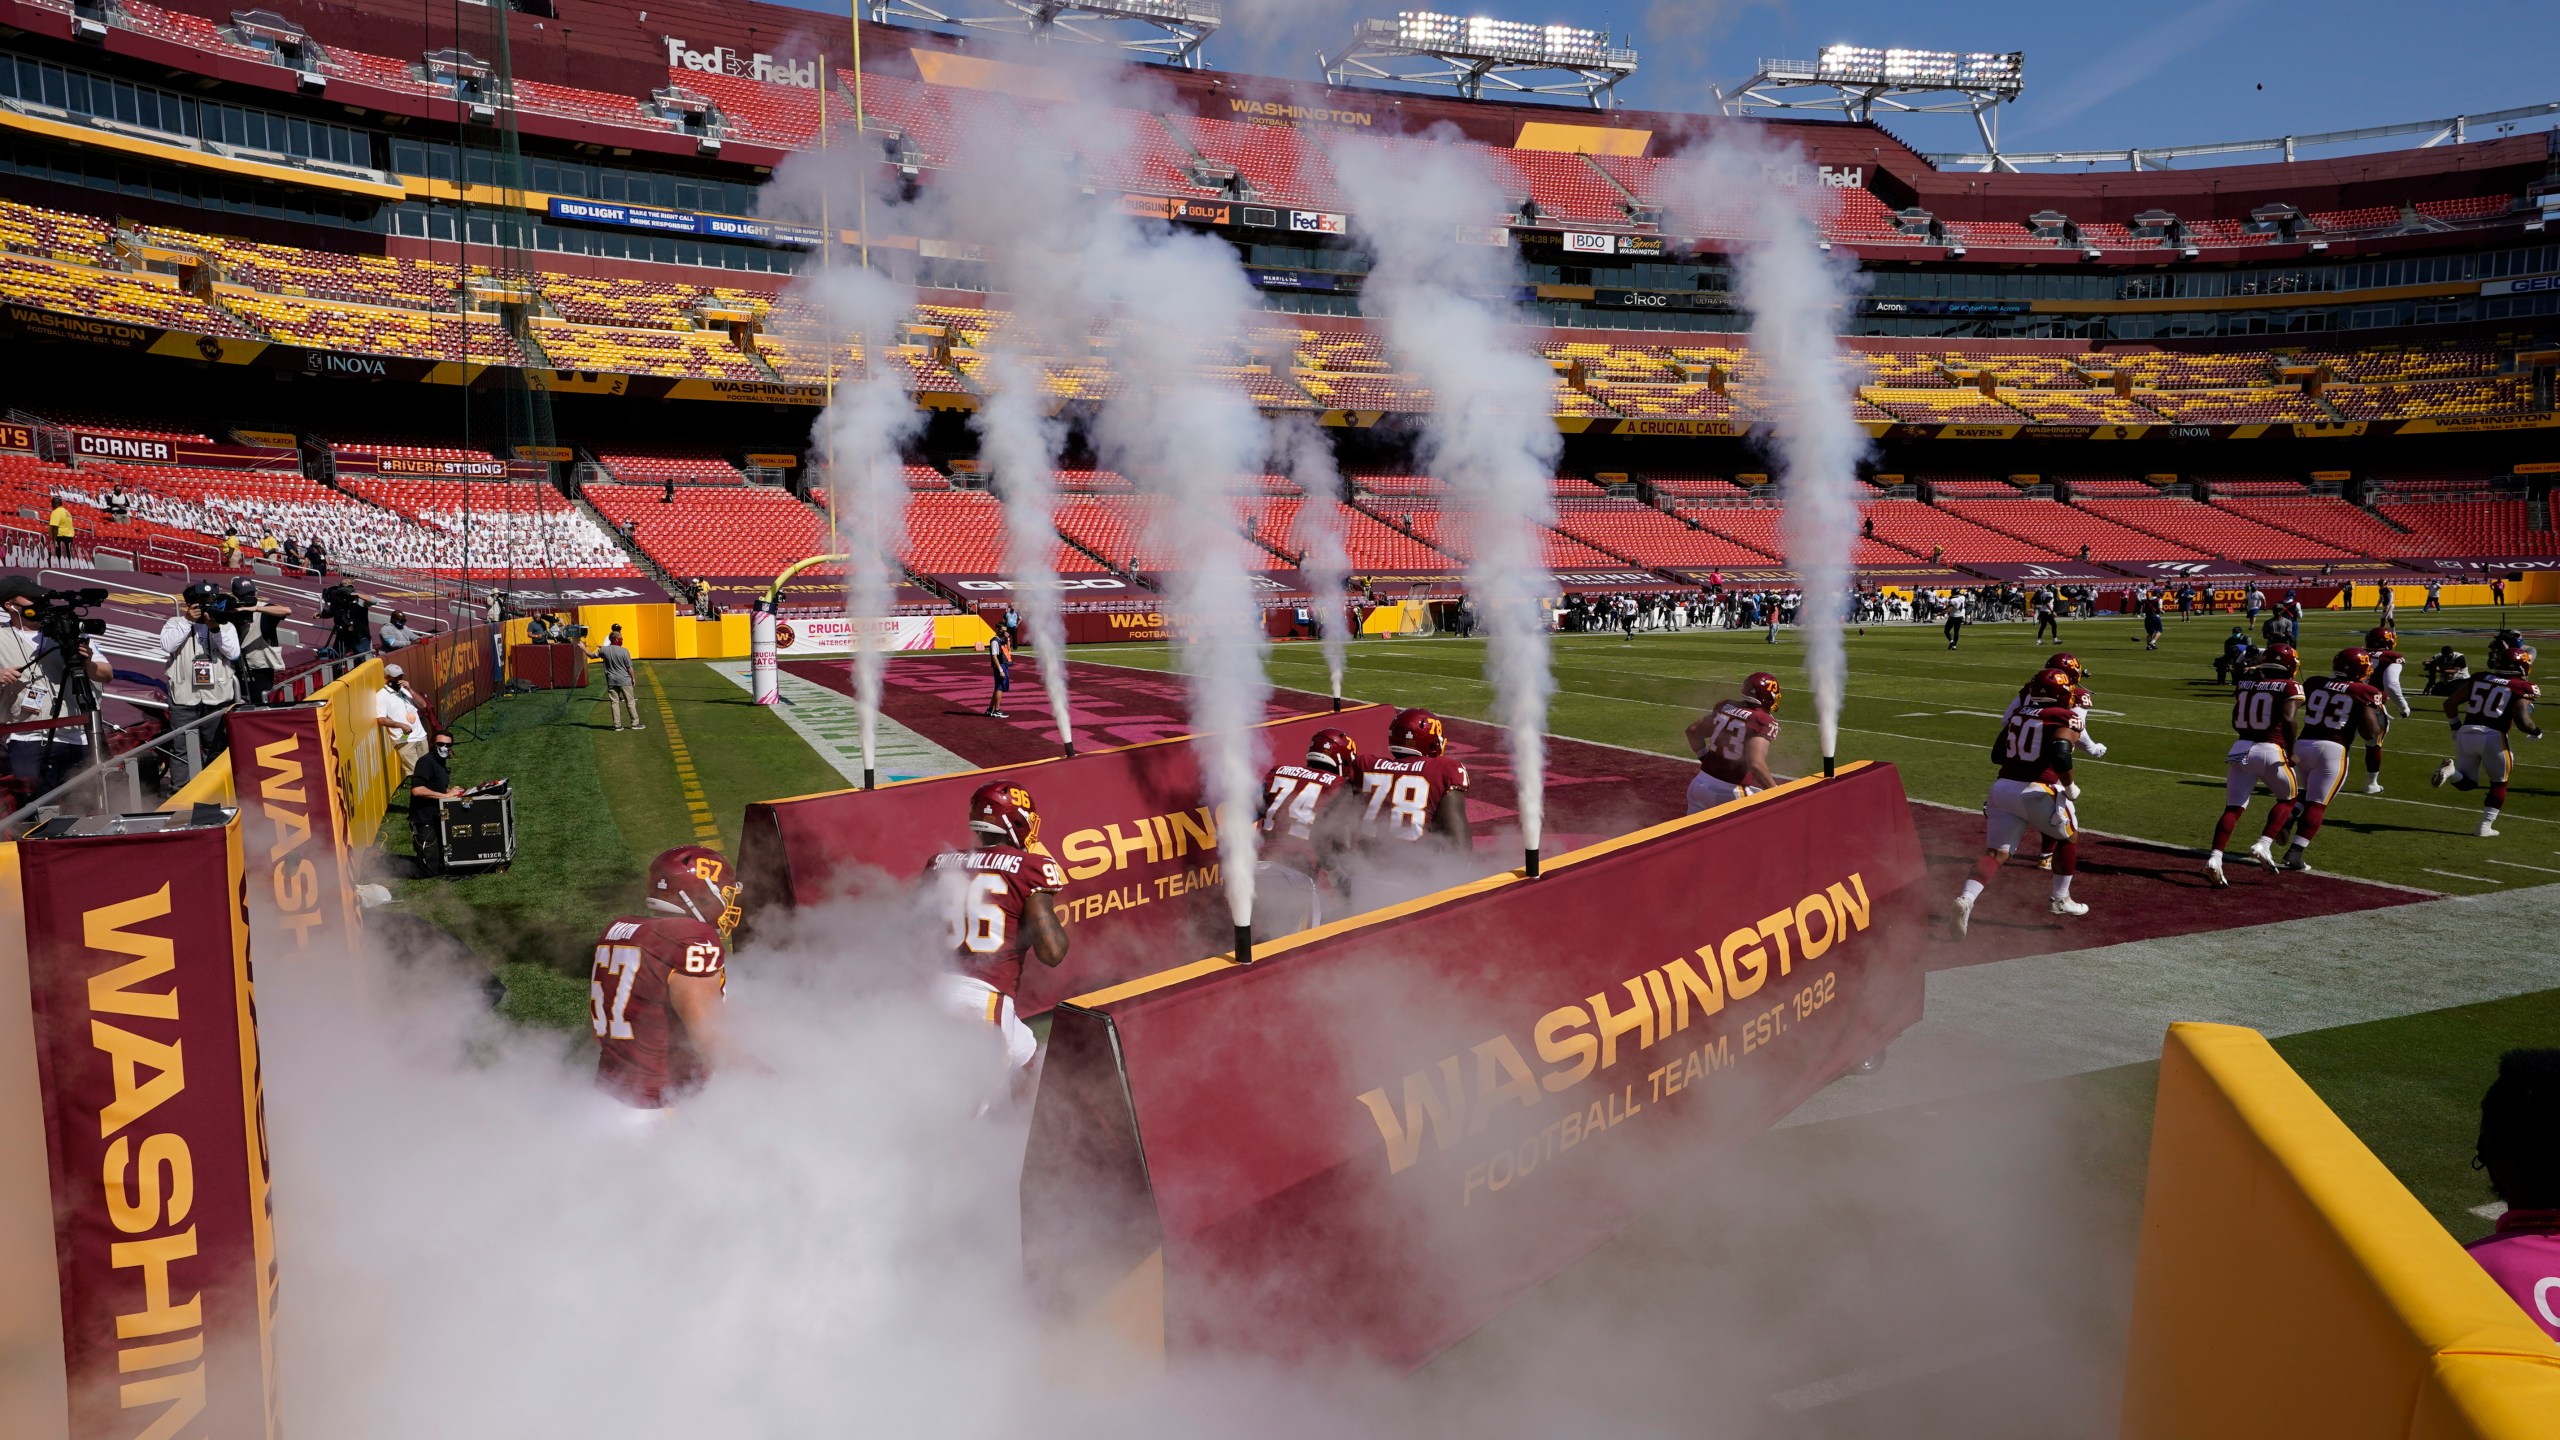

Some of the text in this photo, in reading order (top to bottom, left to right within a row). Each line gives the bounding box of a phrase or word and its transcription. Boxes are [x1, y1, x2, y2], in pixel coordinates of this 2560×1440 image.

[284, 34, 300, 44] 422
[668, 38, 815, 89] FedExField
[472, 69, 486, 78] 423
[1229, 98, 1372, 126] WASHINGTON
[1247, 116, 1290, 127] FOOTBALL
[560, 203, 625, 220] BUD LIGHT
[629, 209, 647, 217] MAKE
[660, 212, 678, 220] RIGHT
[679, 214, 695, 222] CALL
[1188, 206, 1214, 218] GOLD
[629, 218, 695, 231] DRINK RESPONSIBLY
[712, 221, 770, 236] BUD LIGHT
[1293, 212, 1339, 232] FedEx
[1577, 235, 1605, 248] BDO
[1631, 237, 1663, 249] Sports
[177, 254, 194, 264] 316
[1619, 248, 1660, 256] WASHINGTON
[11, 307, 146, 341] WASHINGTON
[27, 324, 66, 338] FOOTBALL
[327, 355, 385, 376] INOVA
[727, 394, 765, 402] FOOTBALL
[1627, 420, 1736, 435] A CRUCIAL CATCH
[2435, 413, 2552, 427] WASHINGTON
[1954, 429, 2003, 437] RAVENS
[2025, 426, 2090, 434] WASHINGTON
[2179, 427, 2211, 438] INOVA
[81, 435, 168, 460] CORNER
[382, 459, 501, 475] #RIVERASTRONG
[957, 578, 1126, 591] GEICO
[808, 623, 859, 634] CRUCIAL
[1765, 679, 1778, 693] 73
[2324, 681, 2350, 693] ALLEN
[2466, 680, 2512, 719] 50
[2234, 690, 2273, 730] 10
[2304, 689, 2353, 730] 93
[1428, 717, 1443, 737] 78
[1766, 723, 1779, 738] 73
[1710, 712, 1747, 761] 73
[2006, 715, 2044, 762] 60
[1374, 758, 1426, 773] LUCAS III
[1320, 772, 1338, 786] SR
[1010, 787, 1031, 809] 96
[1263, 775, 1324, 841] 74
[1361, 771, 1431, 842] 78
[696, 857, 723, 883] 67
[933, 851, 1024, 875] SMITH-WILLIAMS
[685, 945, 721, 973] 67
[590, 944, 642, 1040] 67
[1356, 872, 1871, 1176] WASHINGTON
[1462, 971, 1837, 1208] FOOTBALL TEAM, EST. 1932
